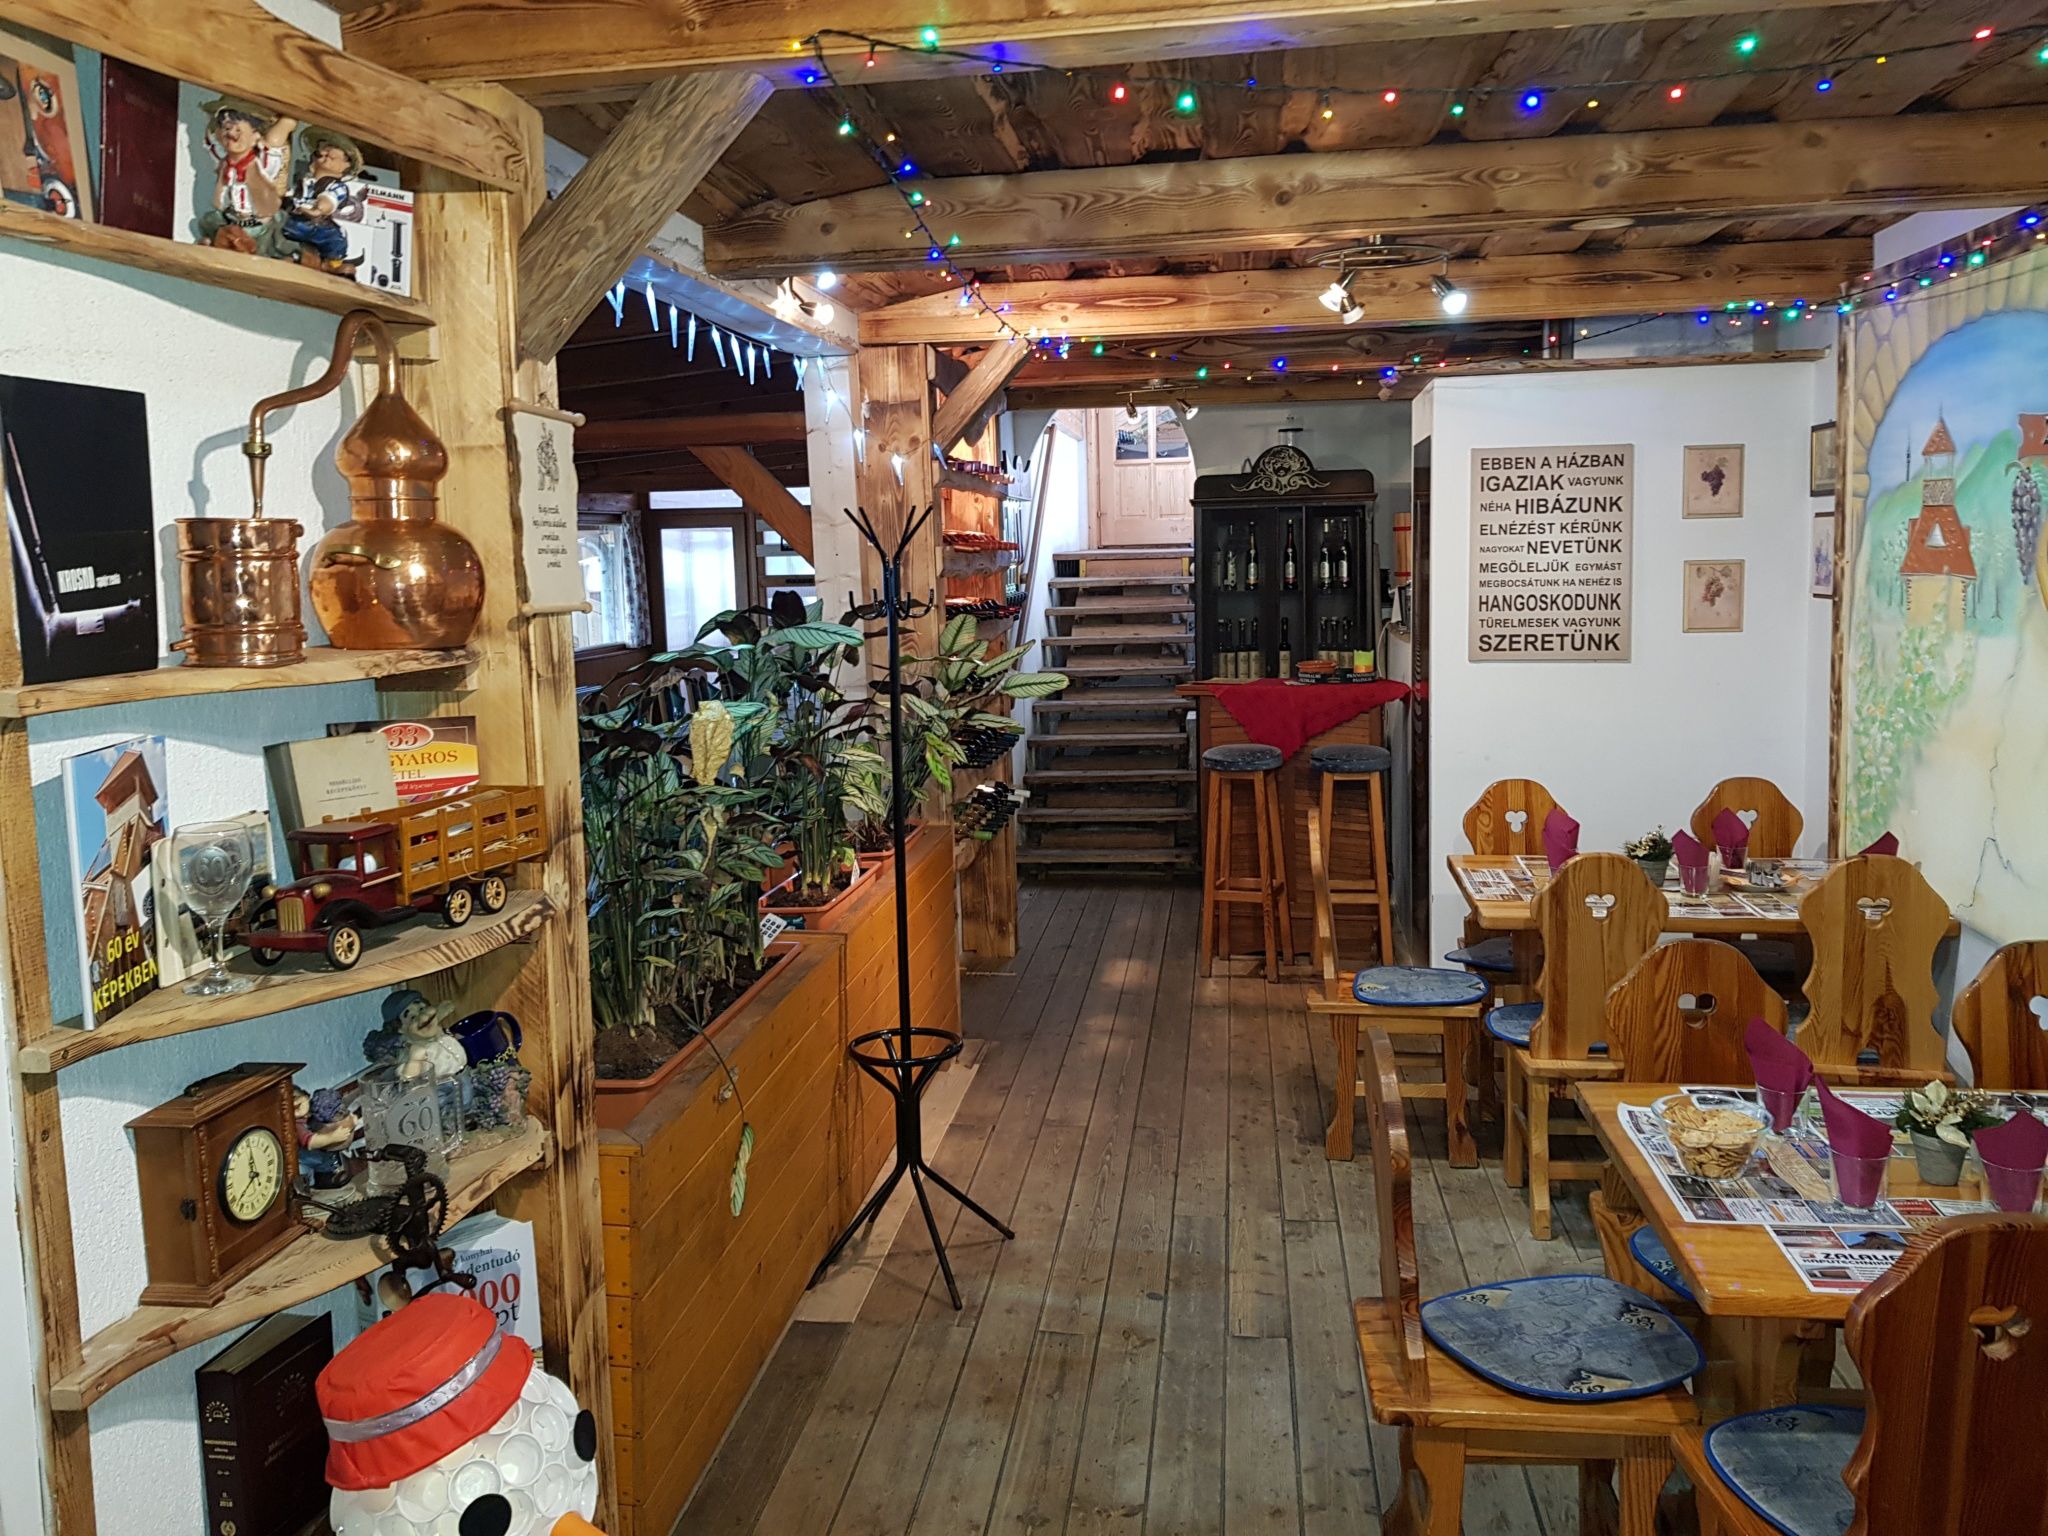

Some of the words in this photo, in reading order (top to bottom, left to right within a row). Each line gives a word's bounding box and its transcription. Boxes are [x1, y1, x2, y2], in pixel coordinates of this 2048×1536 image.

[1480, 456, 1536, 471] EBBEN
[1540, 456, 1551, 469] A
[1556, 451, 1625, 469] HÁZBAN
[1480, 474, 1565, 492] IGAZIAK
[1567, 475, 1624, 487] VAGYUNK
[1480, 500, 1511, 512] NÉHA
[1515, 493, 1623, 515] HIBÁZUNK
[1479, 520, 1556, 536] ELNÉZÉST
[1560, 519, 1623, 534] KÉRÜNK
[1479, 545, 1525, 553] NAGYOKAT
[1527, 536, 1622, 555] NEVETÜNK
[1479, 558, 1570, 573] MEGÖLELJÜK
[1575, 561, 1622, 572] EGYMÁST
[1479, 577, 1560, 588] MEGBOCSÁTUNK
[1562, 578, 1576, 587] HA
[1578, 576, 1611, 587] NEHÉZ
[1613, 577, 1622, 586] IS
[1478, 593, 1622, 612] HANGOSKODUNK
[1479, 616, 1559, 629] TÜRELMESEK
[1562, 617, 1621, 628] VAGYUNK
[1478, 629, 1621, 652] SZERETÜNK
[390, 726, 419, 747] 33
[107, 935, 123, 963] 60
[125, 926, 140, 953] év
[93, 958, 160, 1014] KÉPEKBEN
[398, 1106, 434, 1138] 60
[460, 1246, 494, 1264] konyhai
